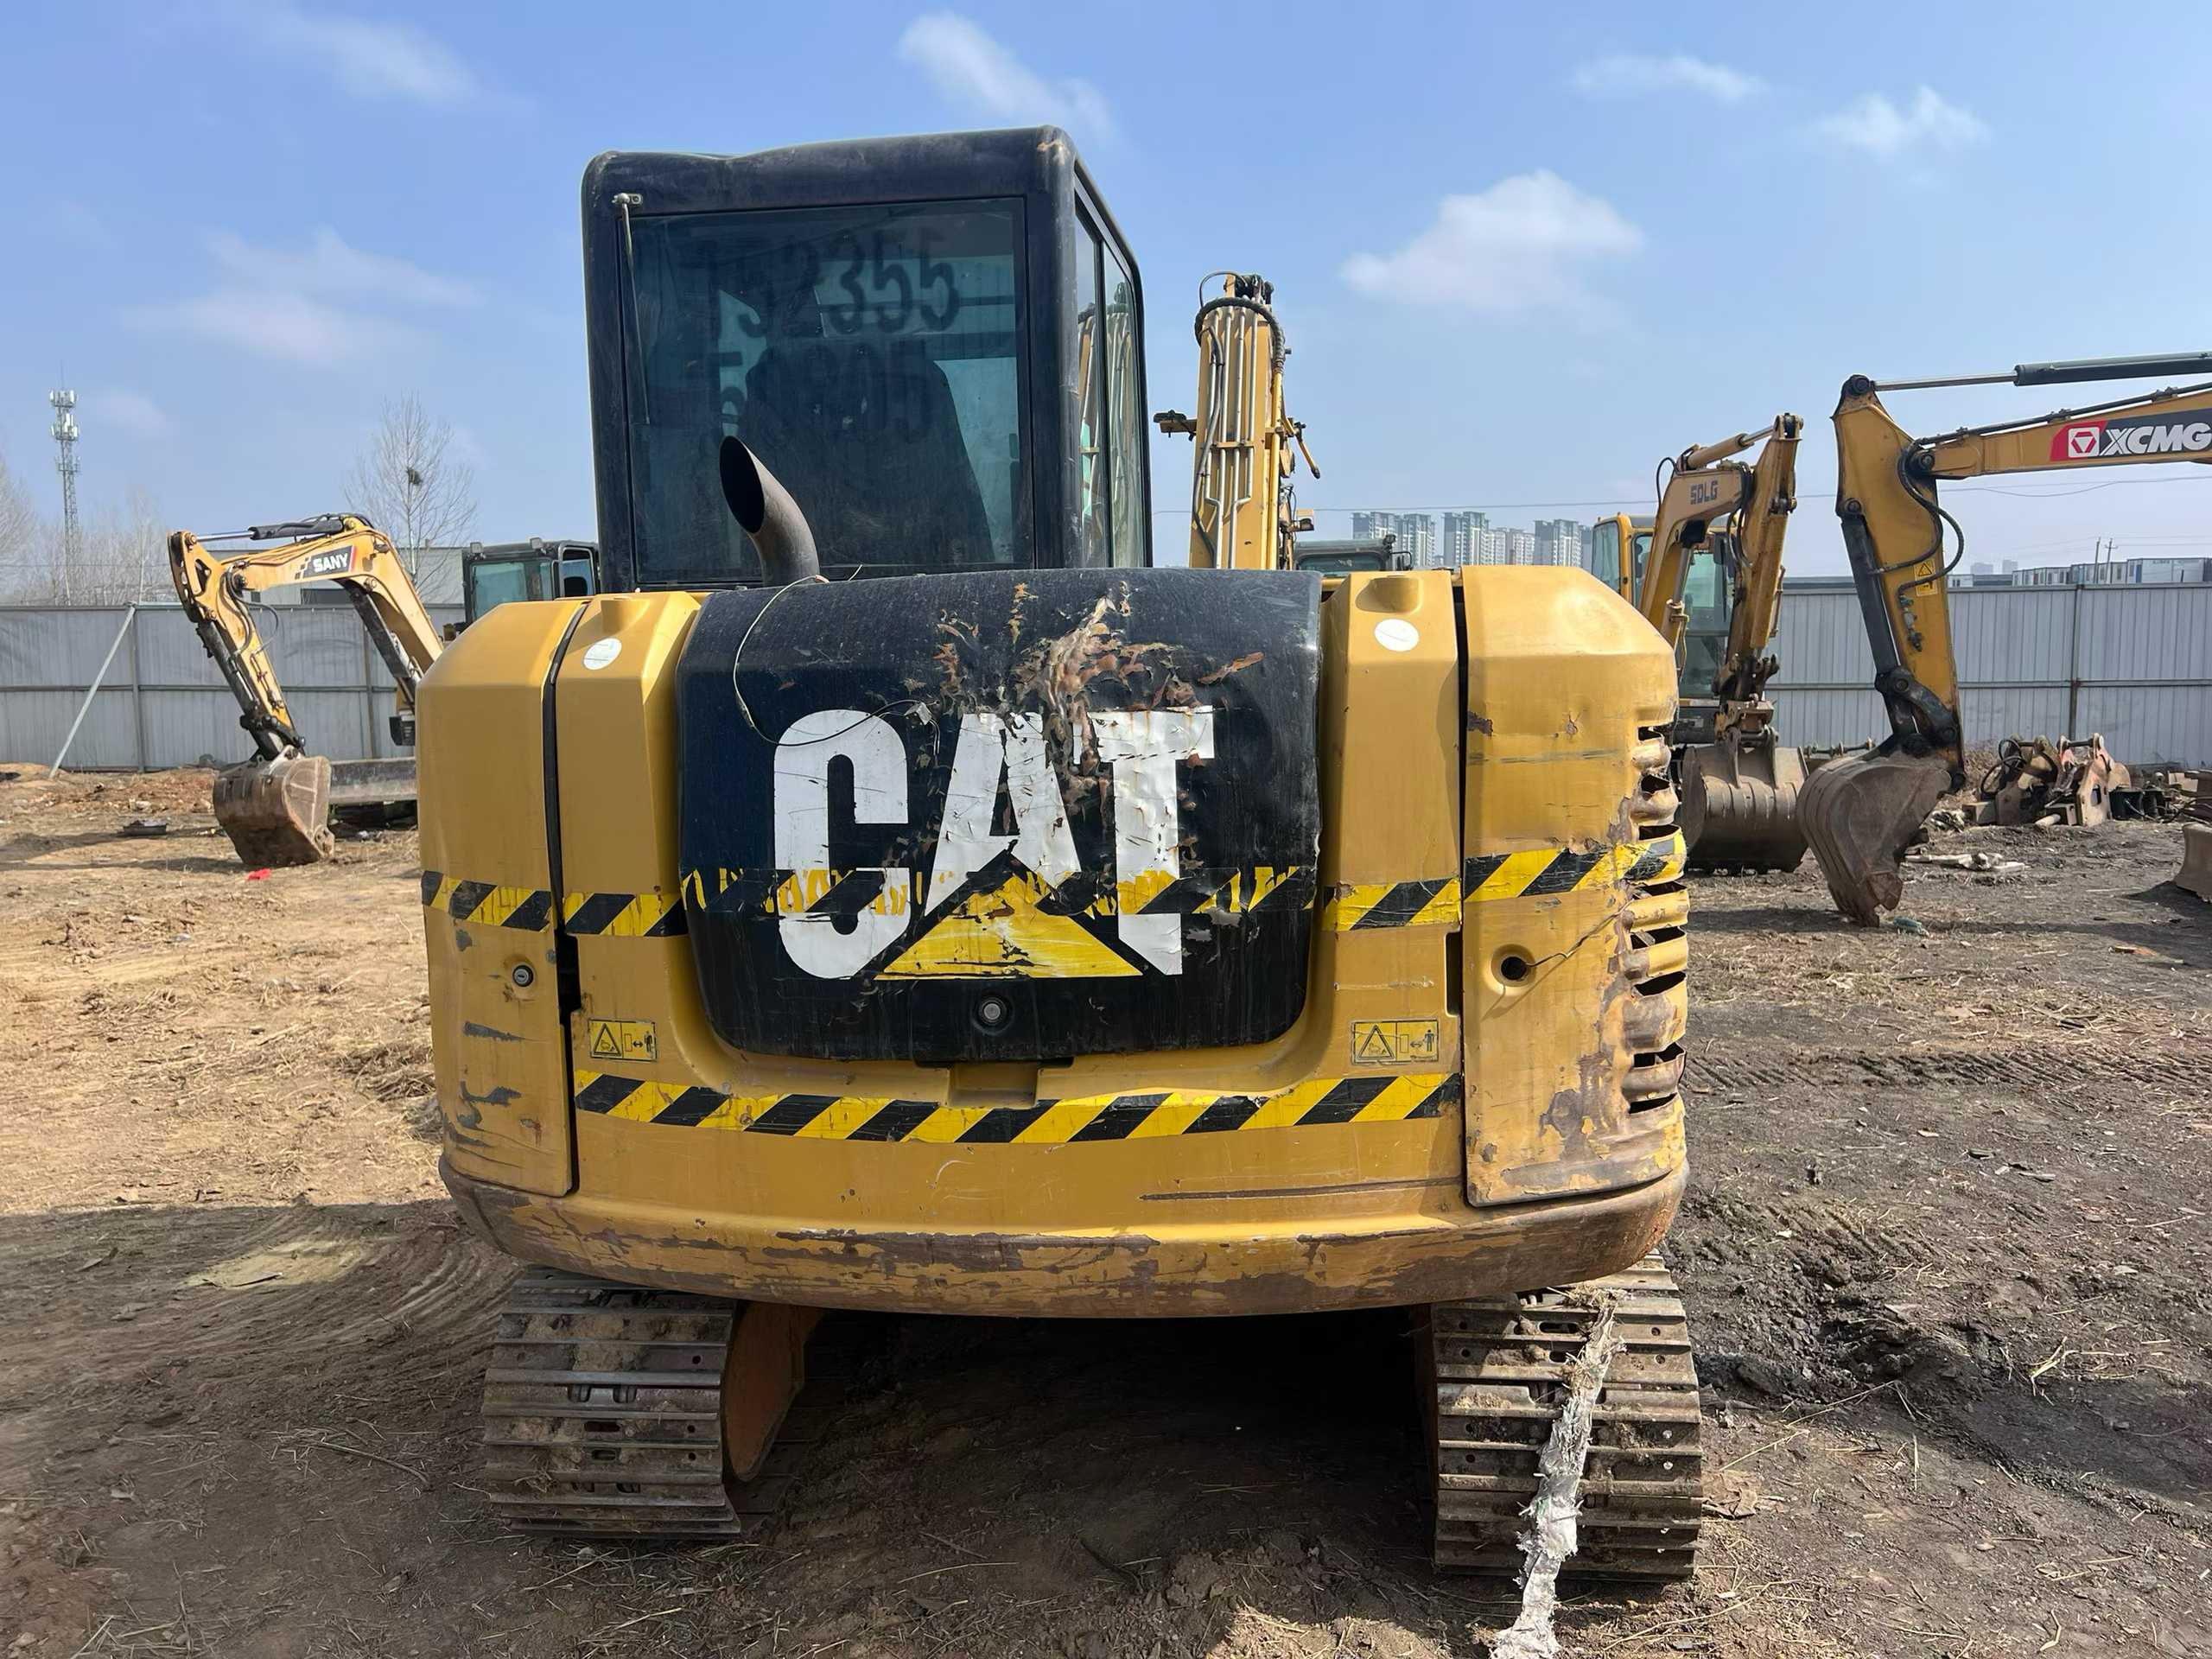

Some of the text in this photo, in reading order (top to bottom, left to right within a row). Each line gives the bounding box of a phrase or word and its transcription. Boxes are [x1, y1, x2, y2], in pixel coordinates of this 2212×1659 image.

[2099, 423, 2212, 456] XCMG
[1690, 480, 1718, 505] SDLG
[313, 553, 348, 572] SANY
[774, 705, 1214, 980] CAT
